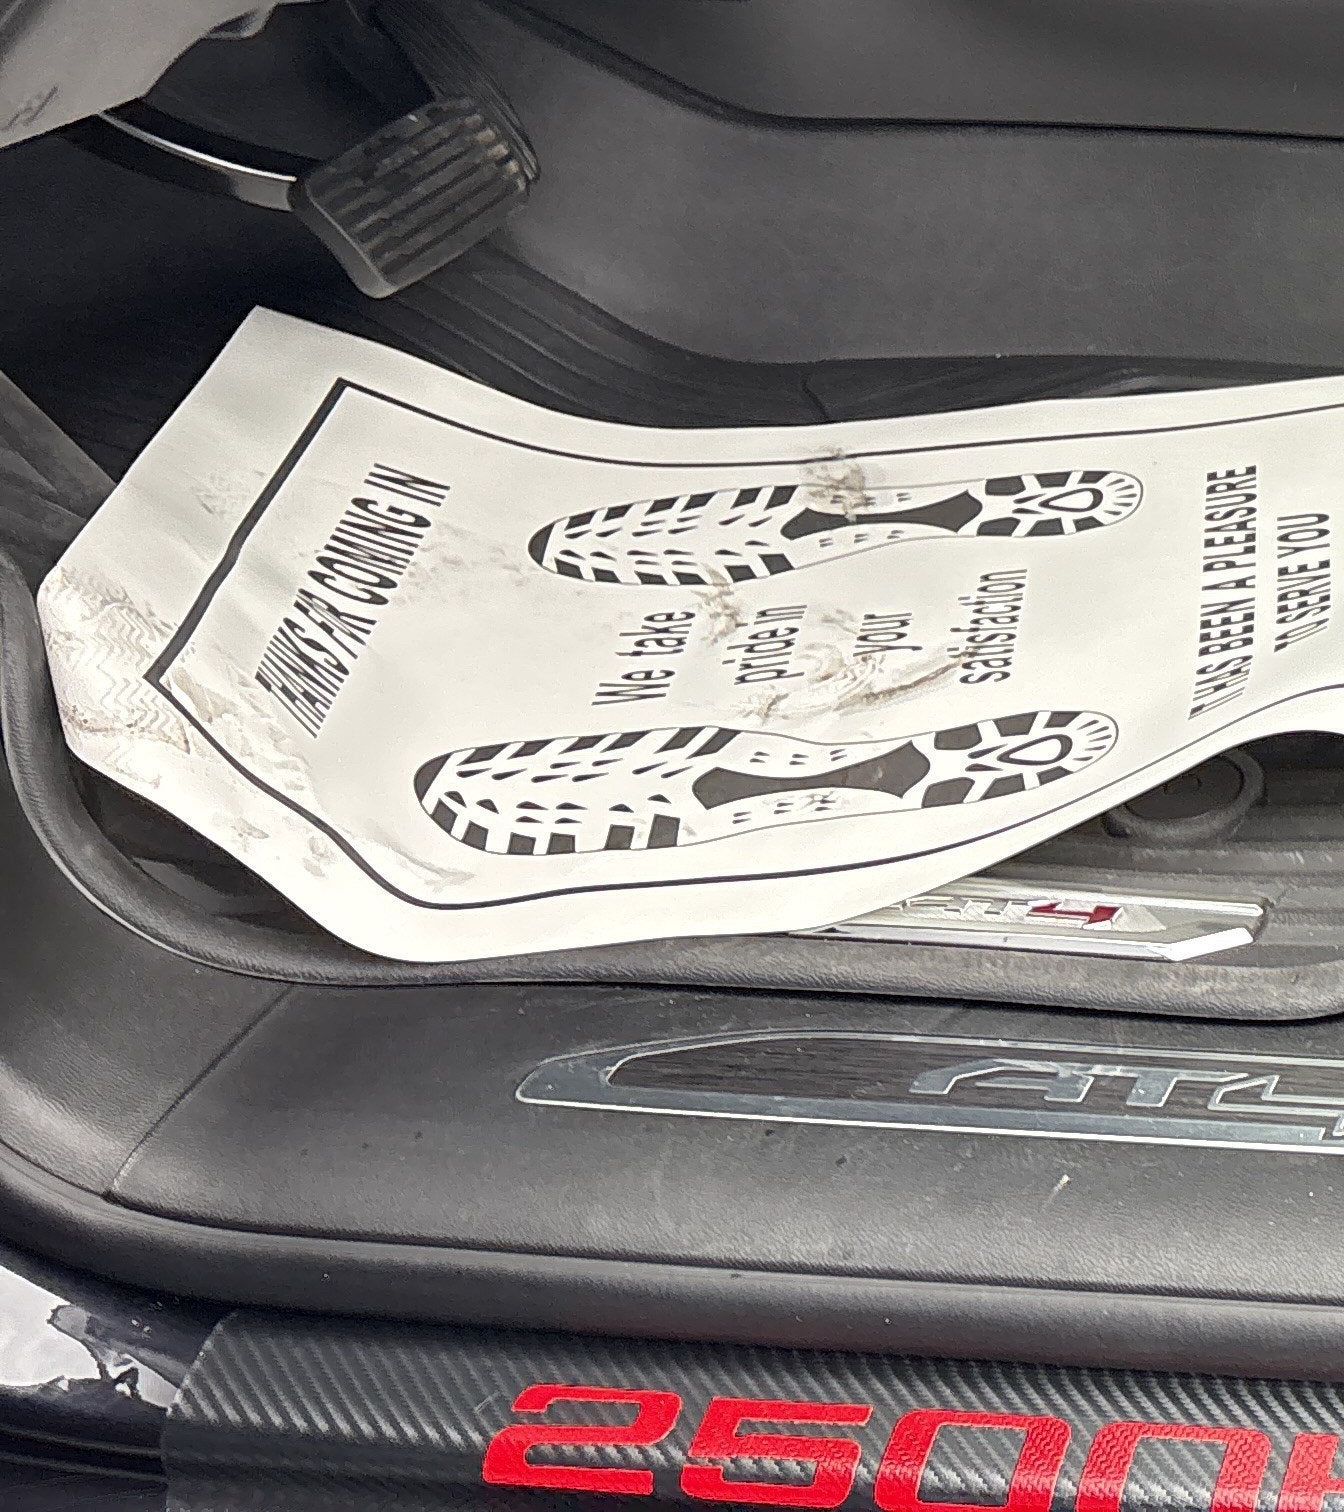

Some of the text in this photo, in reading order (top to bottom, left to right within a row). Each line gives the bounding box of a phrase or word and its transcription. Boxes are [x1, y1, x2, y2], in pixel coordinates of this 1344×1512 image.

[364, 462, 451, 508] IN
[1203, 465, 1256, 572] PLEASURE
[307, 495, 431, 603] COMING
[1202, 575, 1255, 591] A
[1274, 513, 1331, 653] TO SERVE YOU
[592, 611, 695, 705] We take
[722, 605, 807, 685] pride in
[853, 612, 922, 657] your
[947, 568, 1027, 684] satisfaction
[1198, 597, 1255, 656] BEEN
[253, 617, 352, 738] THANKS
[1193, 655, 1253, 701] HAS
